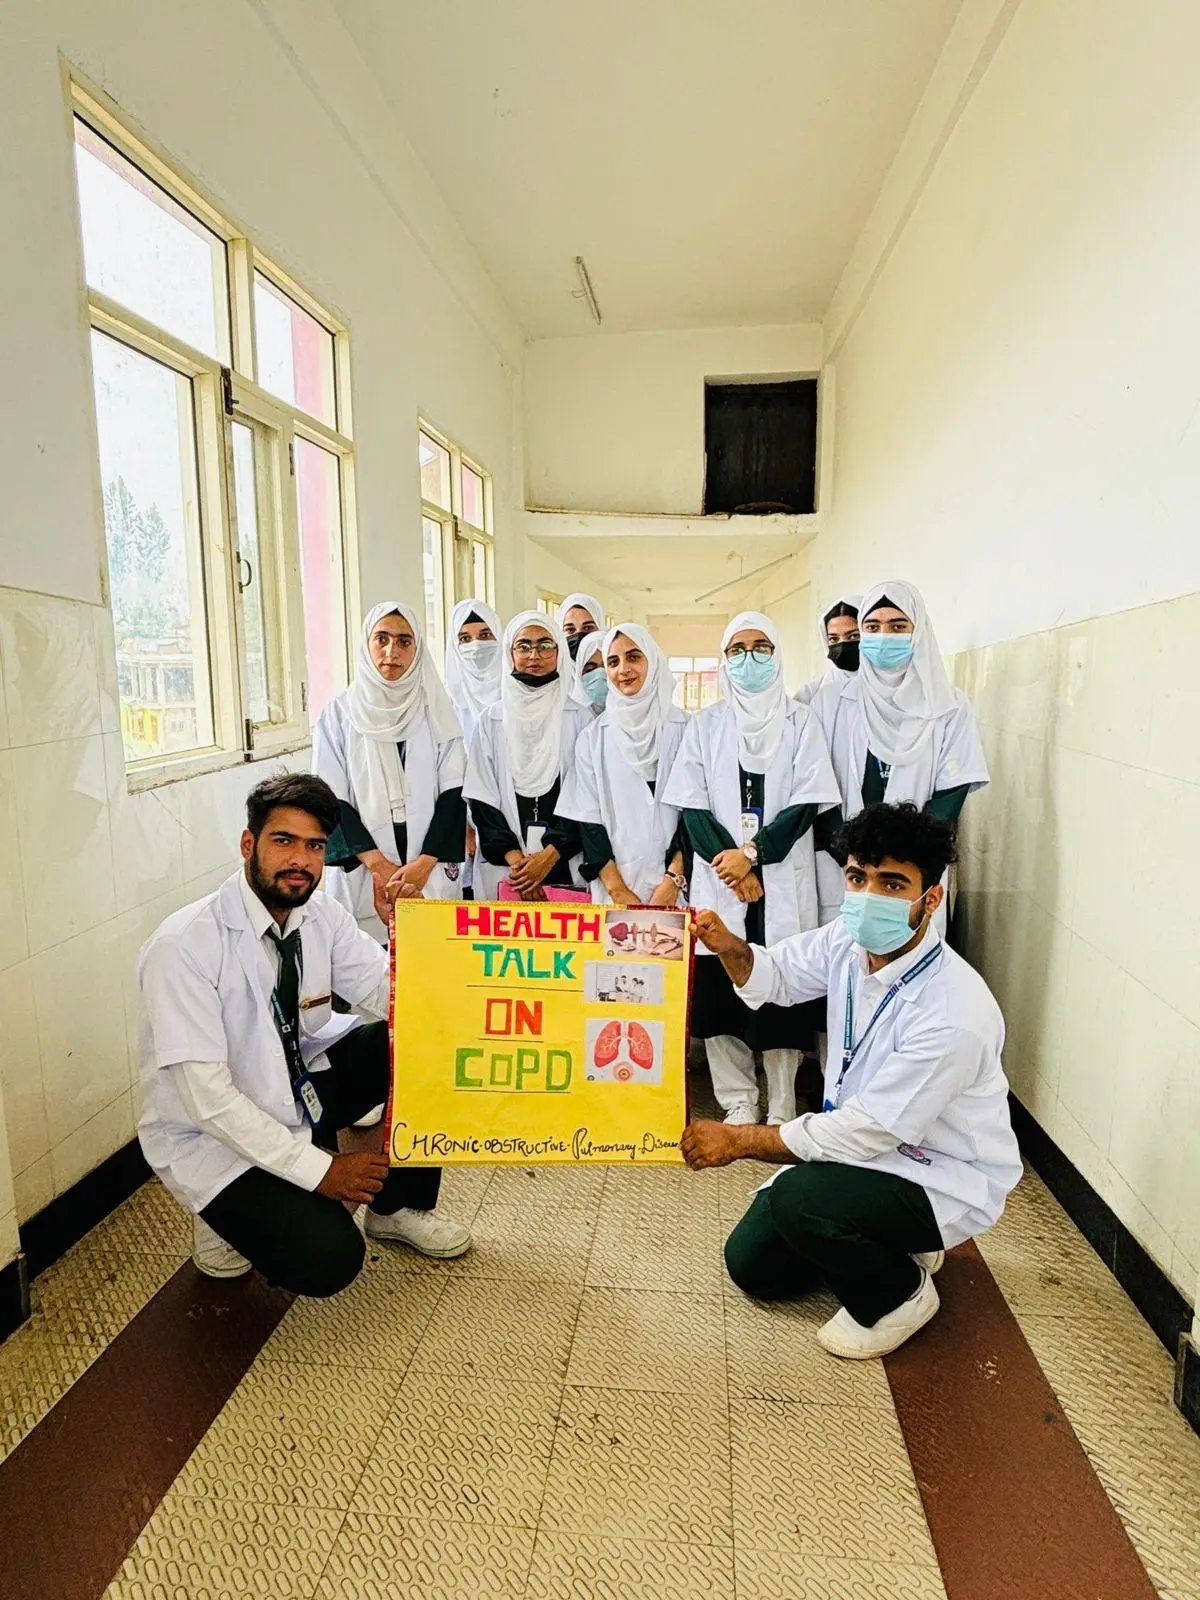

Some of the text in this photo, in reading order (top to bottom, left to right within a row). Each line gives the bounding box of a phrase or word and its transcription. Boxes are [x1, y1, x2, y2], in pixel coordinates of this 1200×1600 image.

[455, 906, 601, 941] HEALTH
[472, 943, 576, 979] TALK
[485, 998, 542, 1035] ON
[455, 1047, 572, 1091] COPD
